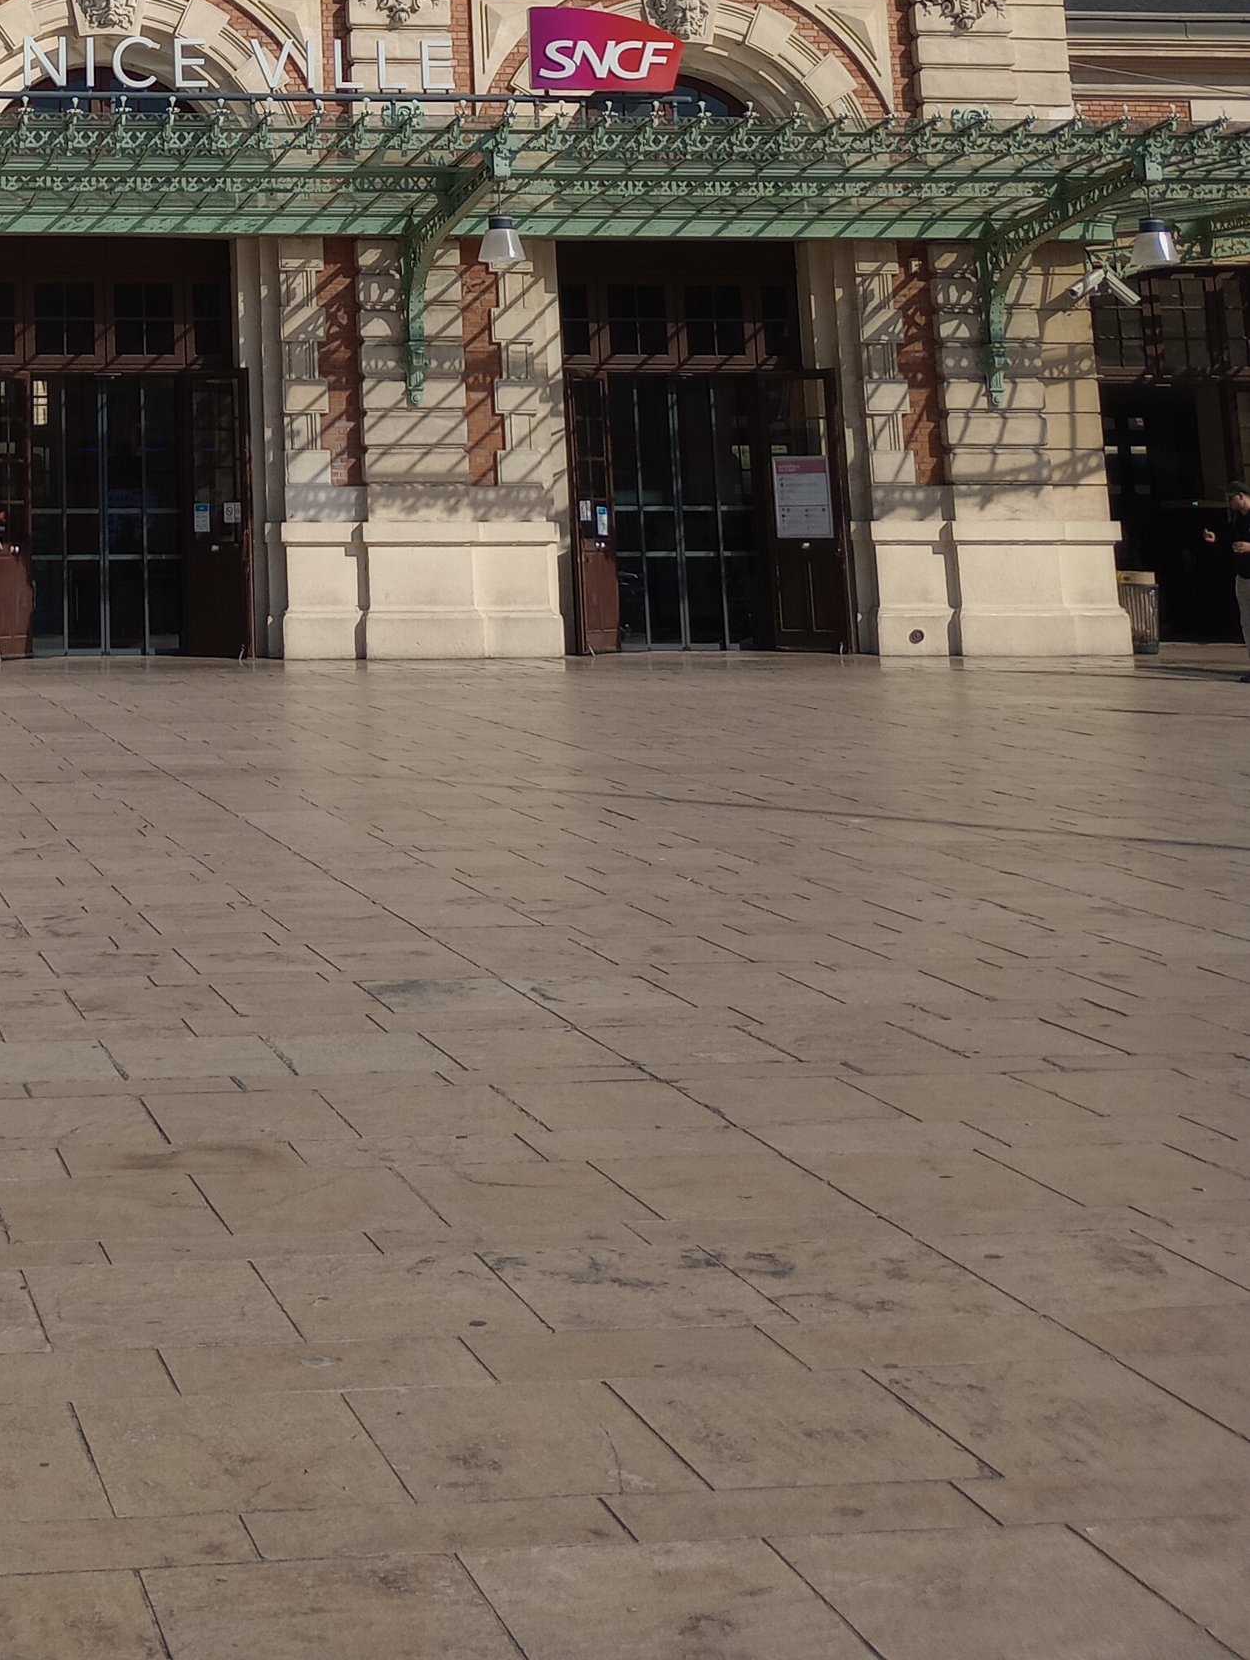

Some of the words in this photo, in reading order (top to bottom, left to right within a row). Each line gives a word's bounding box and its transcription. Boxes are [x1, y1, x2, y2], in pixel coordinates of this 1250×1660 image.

[23, 35, 208, 89] NICE
[250, 38, 455, 90] VILLE
[539, 39, 675, 81] SNCF
